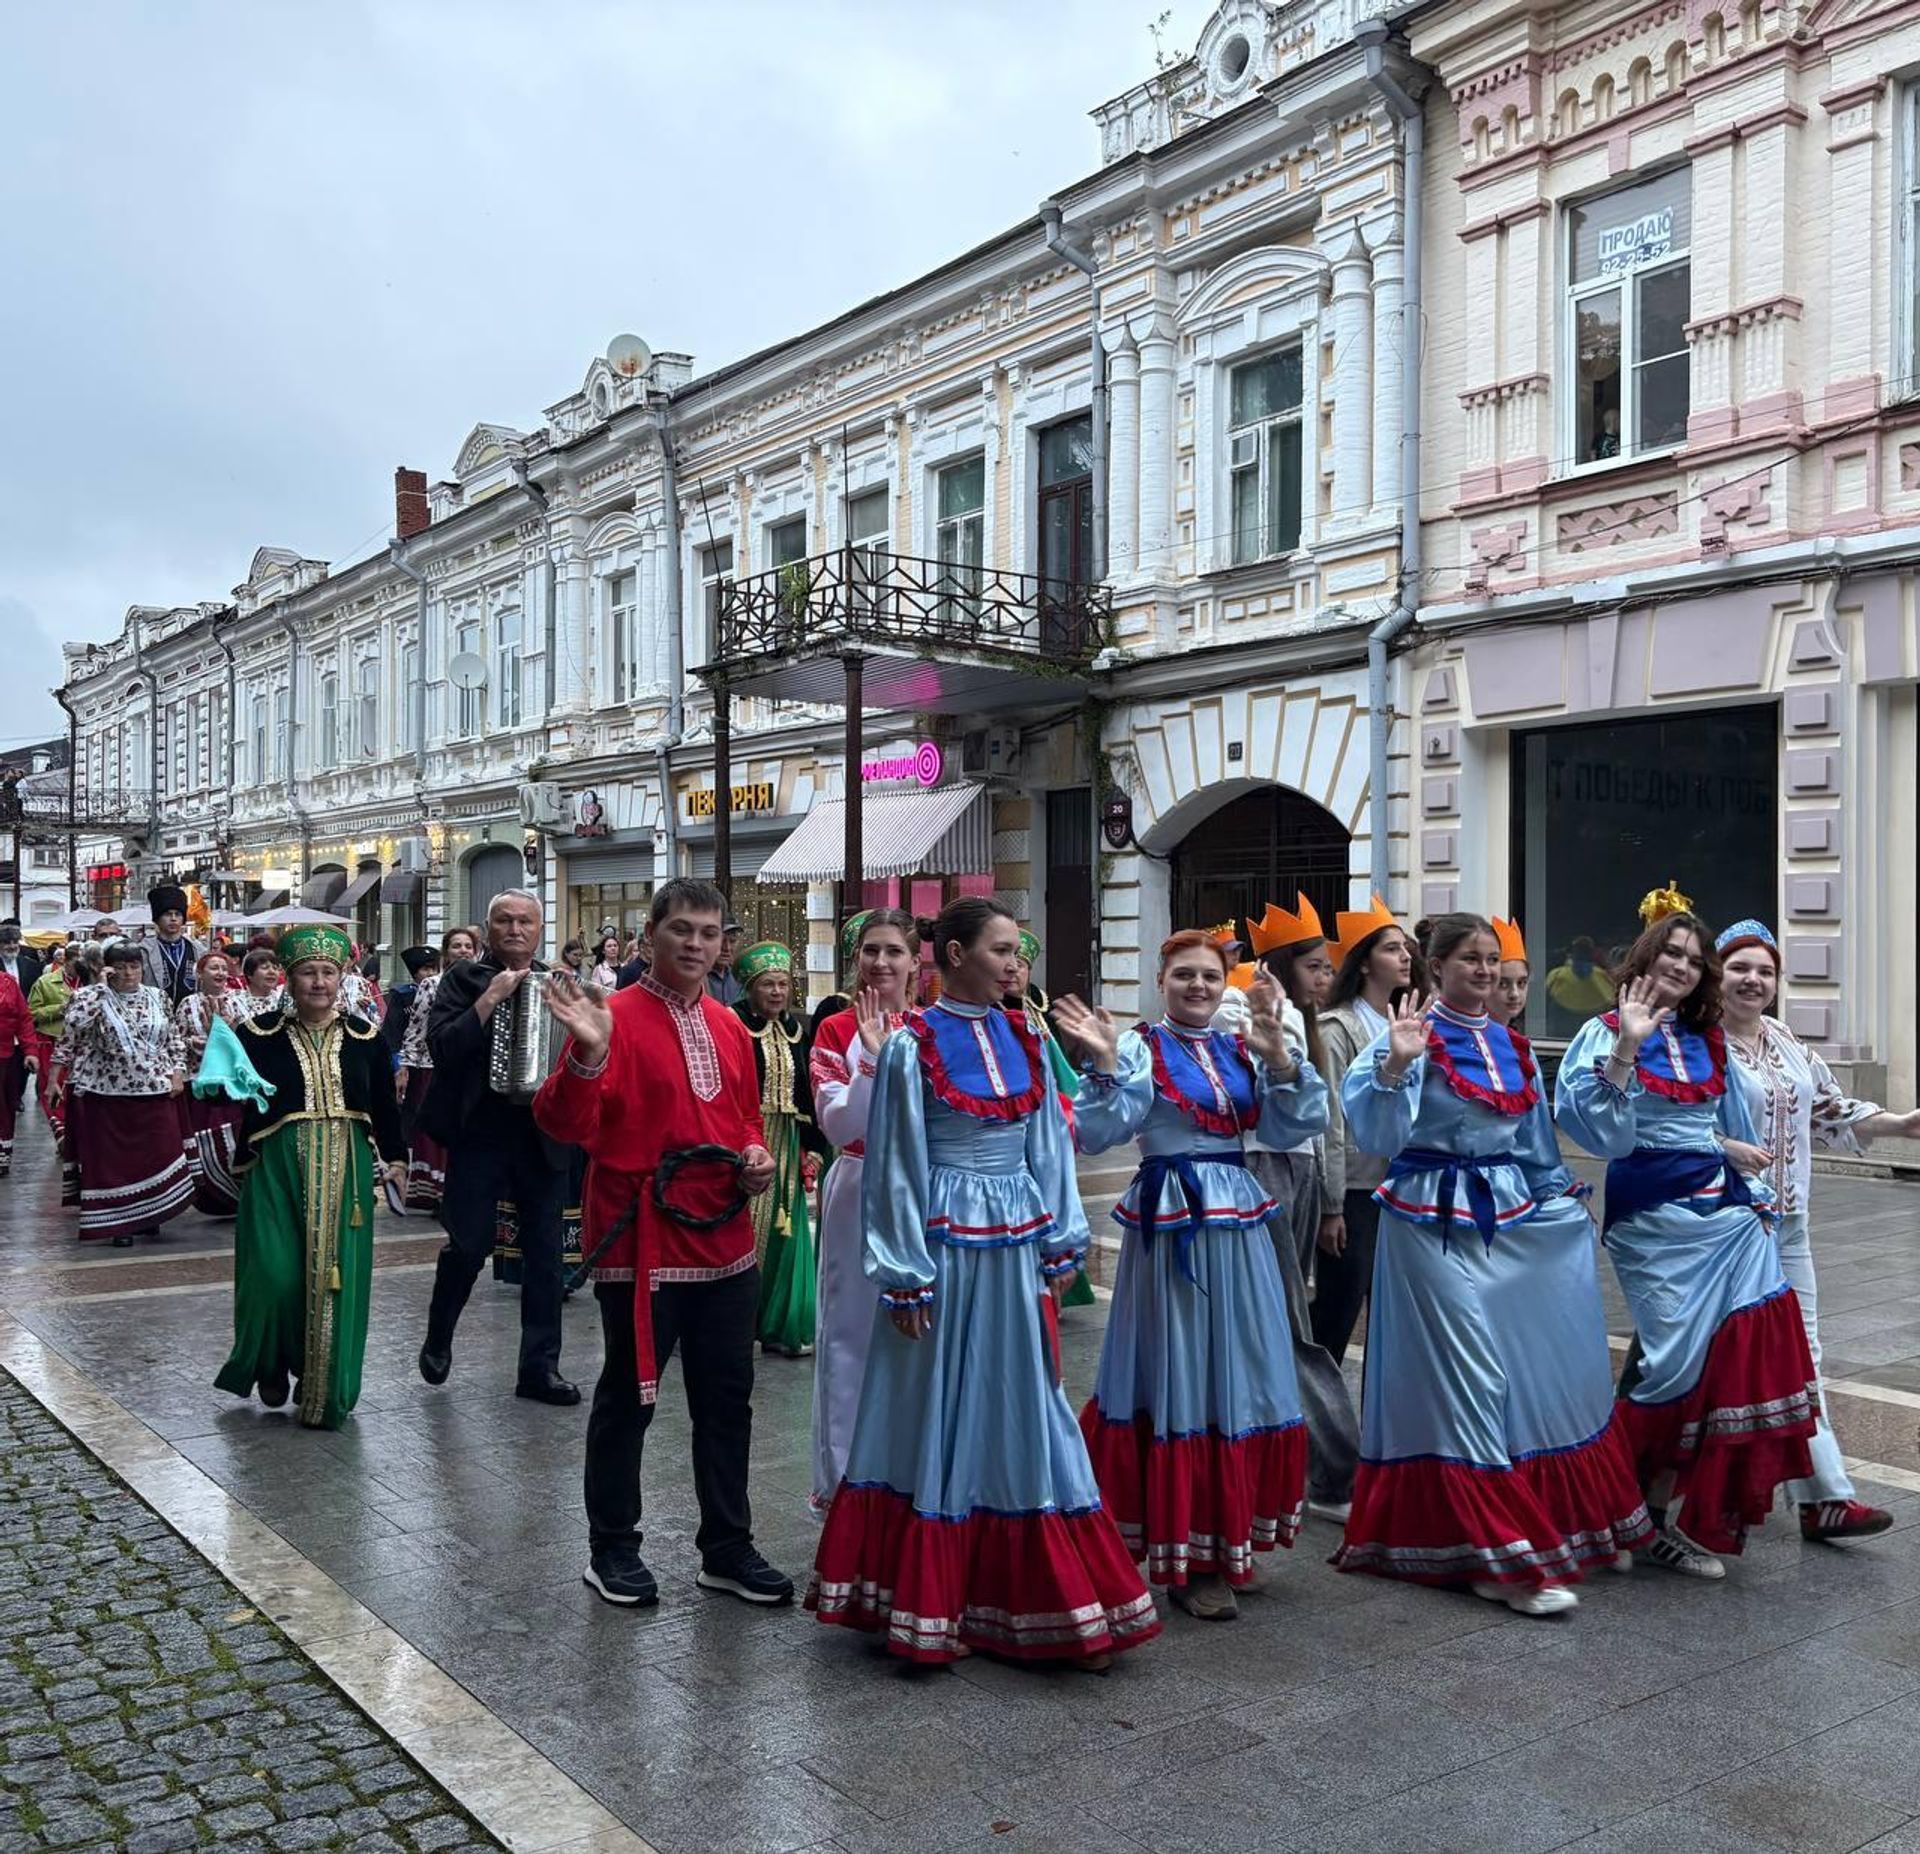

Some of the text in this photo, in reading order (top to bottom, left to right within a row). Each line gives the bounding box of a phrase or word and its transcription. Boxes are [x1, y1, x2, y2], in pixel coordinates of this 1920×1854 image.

[1602, 213, 1672, 254] ПРОДАЮ
[862, 757, 916, 782] МЕРАНЦИЯ
[686, 784, 772, 816] ПЕКРНЯ
[1575, 763, 1688, 813] ПОБЕДЫ
[1696, 771, 1713, 811] К
[1719, 775, 1769, 816] ПОБ
[1112, 804, 1124, 814] 20
